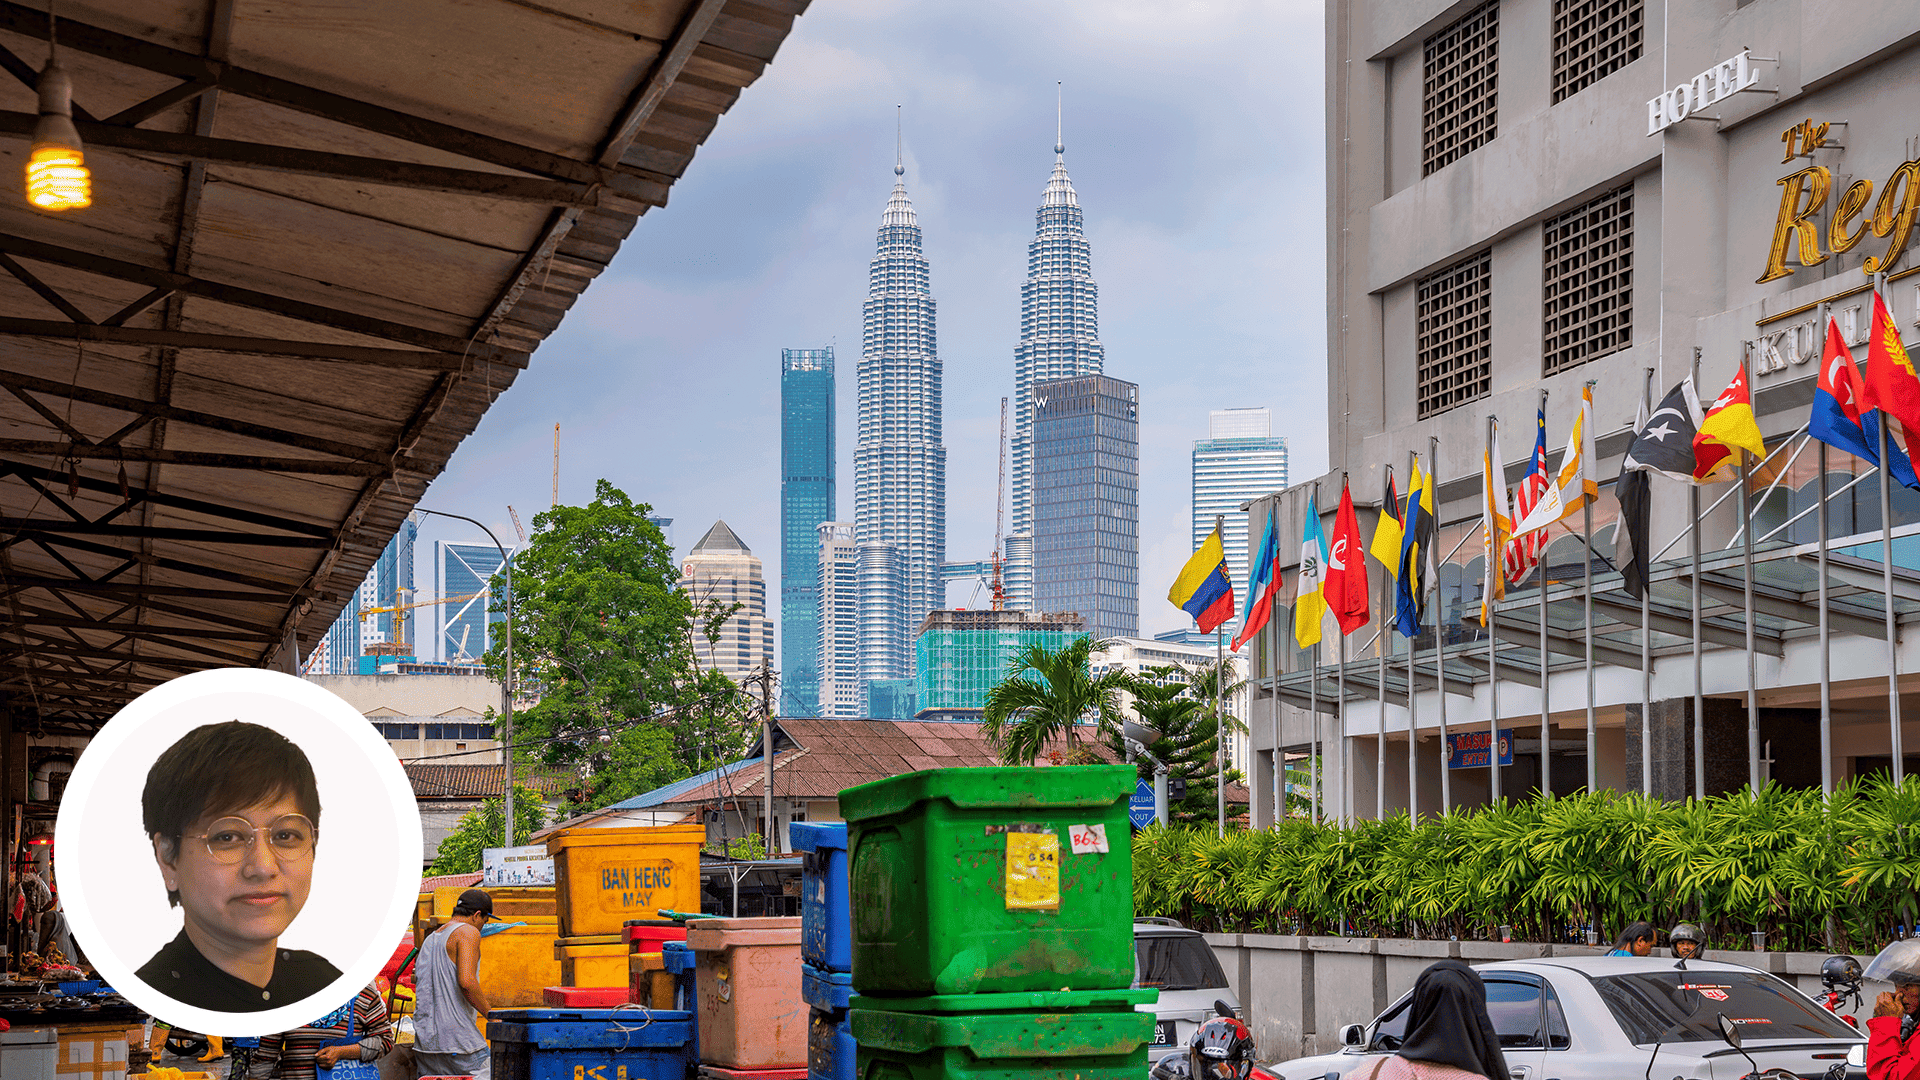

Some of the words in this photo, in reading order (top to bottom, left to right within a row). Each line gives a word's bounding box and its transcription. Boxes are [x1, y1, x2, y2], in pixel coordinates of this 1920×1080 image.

[1646, 50, 1760, 137] HOTEL
[1781, 118, 1830, 164] The
[1034, 395, 1048, 409] W
[1462, 751, 1490, 765] ENTRY
[1129, 795, 1154, 803] KELUAR
[1134, 813, 1149, 821] OUT
[602, 867, 630, 891] BAN
[633, 866, 672, 889] HENG
[622, 892, 653, 908] MAY
